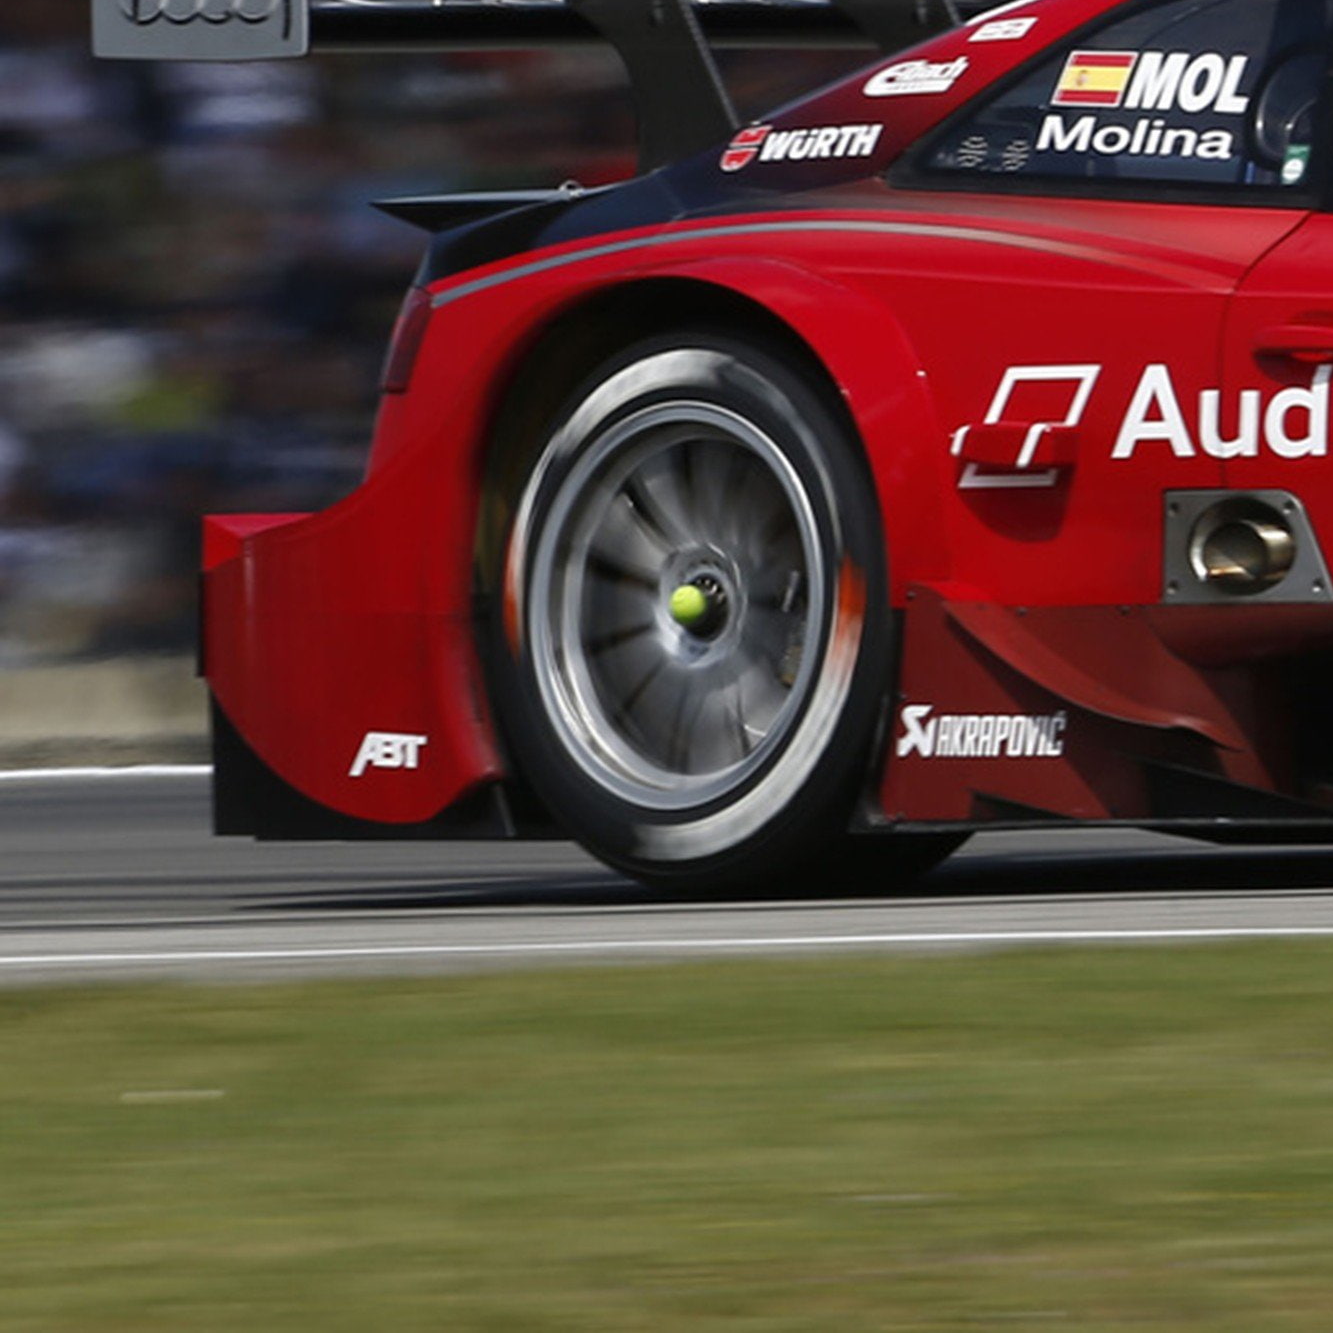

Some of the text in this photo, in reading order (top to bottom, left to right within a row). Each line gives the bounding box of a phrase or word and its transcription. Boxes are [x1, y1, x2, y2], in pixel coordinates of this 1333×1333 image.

[1124, 51, 1249, 113] MOL
[1035, 115, 1234, 159] Molina
[349, 731, 428, 777] ABT
